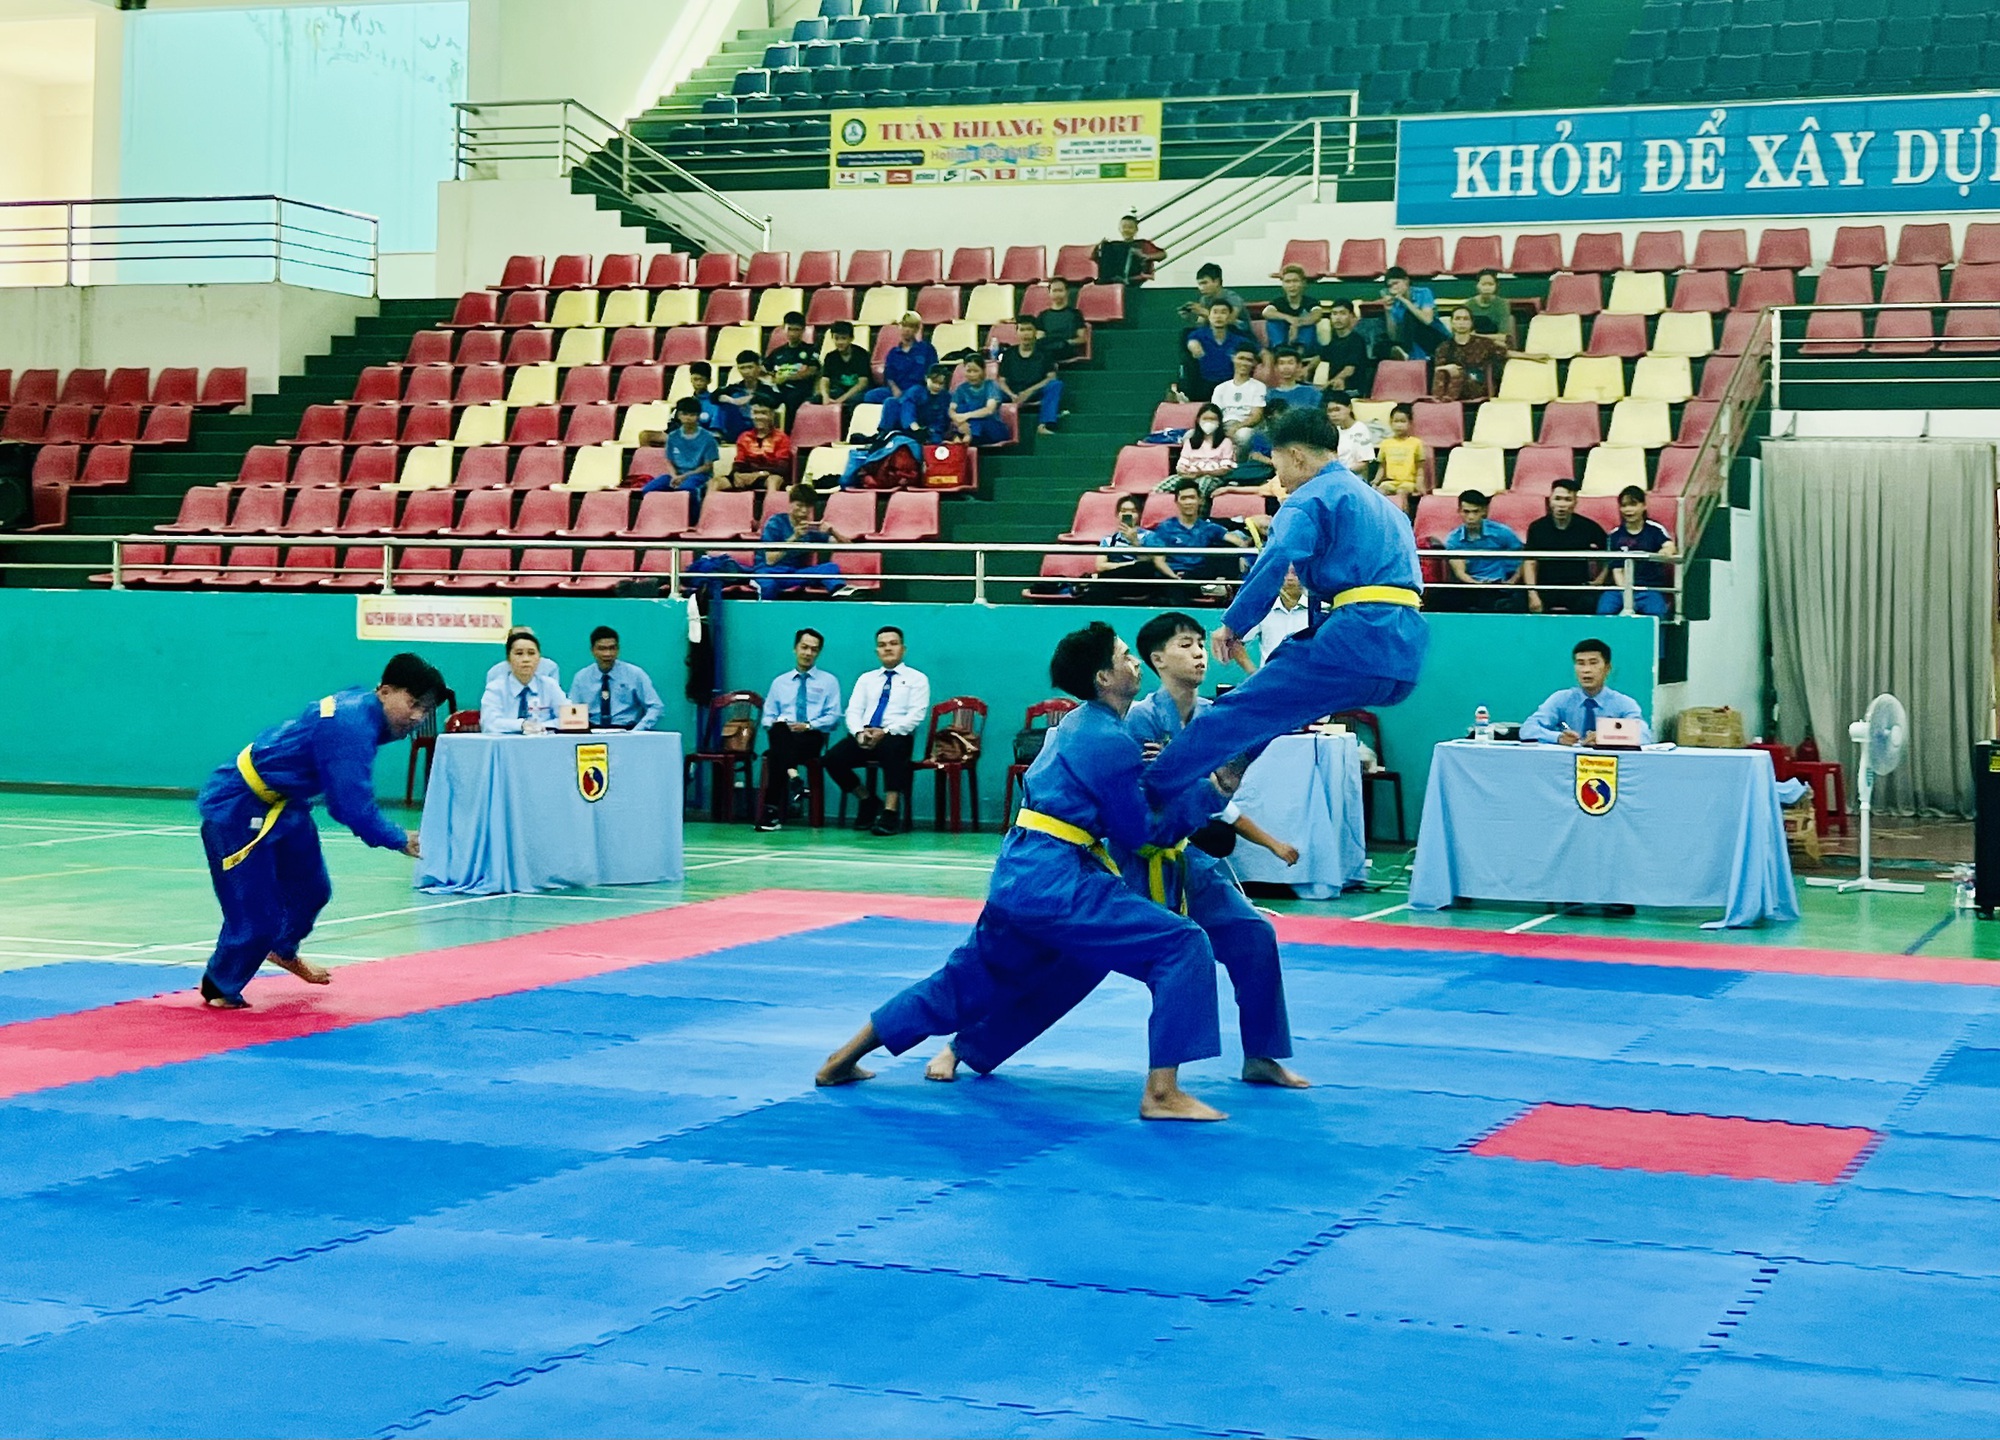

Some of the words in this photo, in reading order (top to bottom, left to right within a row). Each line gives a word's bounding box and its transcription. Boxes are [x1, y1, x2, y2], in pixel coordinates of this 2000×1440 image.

[953, 118, 1044, 139] KHANG
[1053, 115, 1144, 135] SPORT
[1451, 120, 1622, 198] KHỎE
[1639, 109, 1727, 193] ĐỂ
[1745, 117, 1875, 188] XÂY
